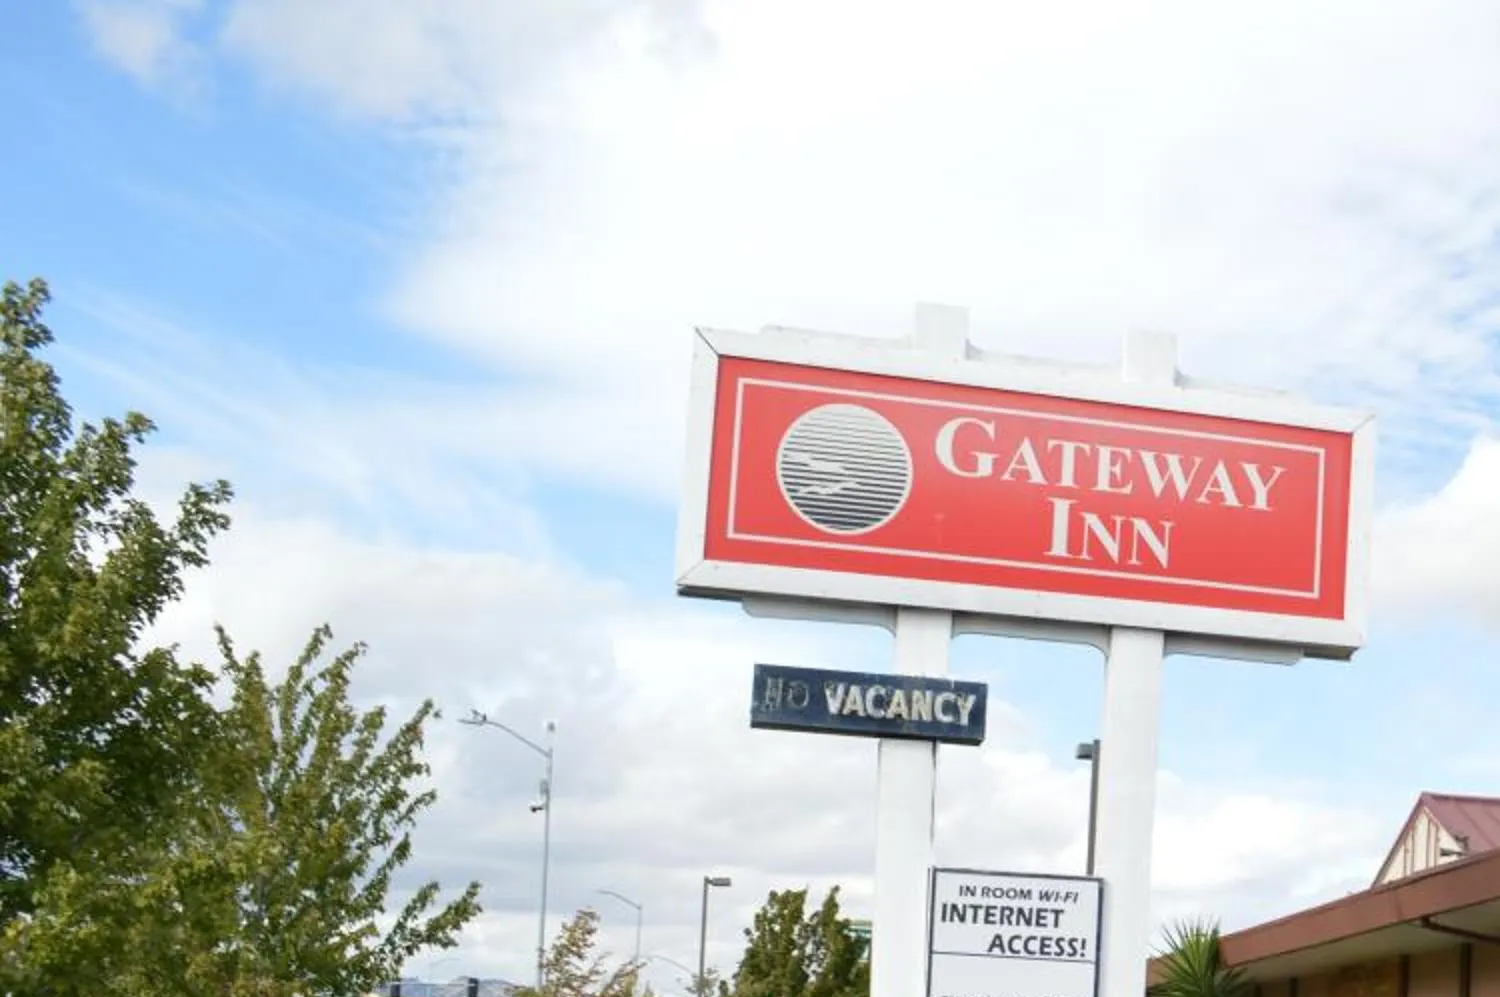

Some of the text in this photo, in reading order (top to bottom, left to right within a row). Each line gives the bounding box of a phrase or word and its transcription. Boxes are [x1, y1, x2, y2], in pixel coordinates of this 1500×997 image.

[935, 416, 1287, 511] GATEWAY
[1043, 497, 1175, 570] INN
[763, 676, 977, 726] NO VACANCY
[958, 884, 1079, 905] IN ROOM WI-FI
[940, 903, 1065, 928] INTERNET
[986, 933, 1087, 957] ACCESS!
